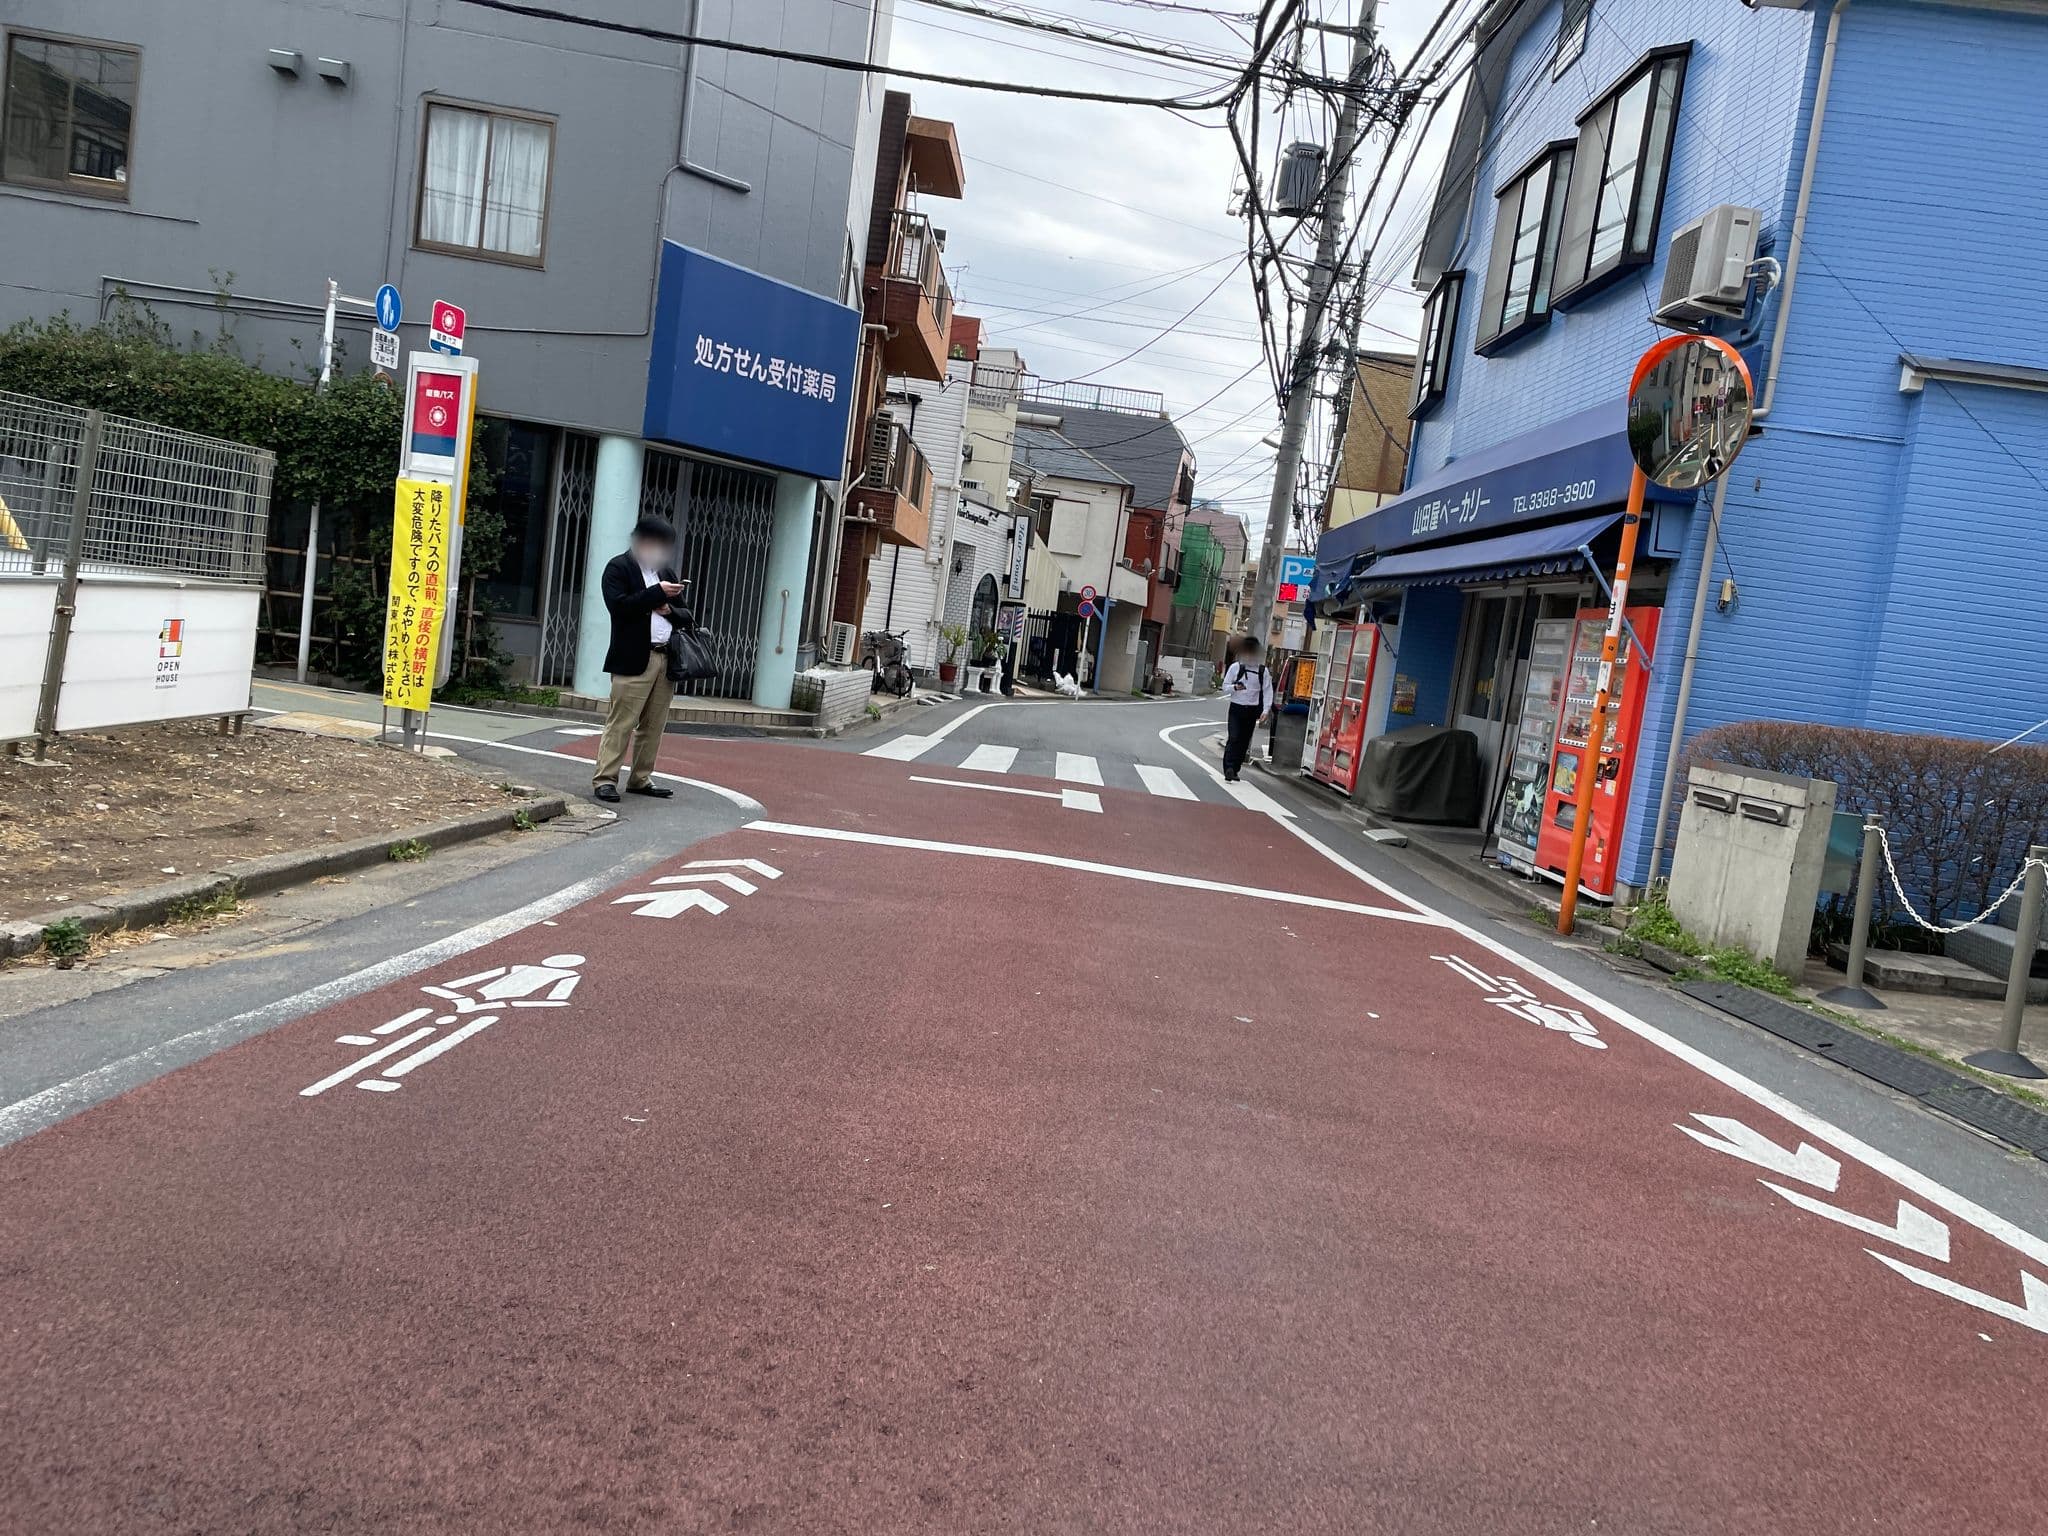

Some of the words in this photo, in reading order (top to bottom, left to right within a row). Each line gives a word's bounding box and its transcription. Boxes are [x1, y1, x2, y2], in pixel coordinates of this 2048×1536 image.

[694, 334, 836, 403] 処方せん受付薬局
[1411, 487, 1491, 536] 山田屋ベーカリー
[1512, 495, 1527, 513] TEL
[1528, 479, 1596, 511] 3388-3900
[412, 489, 443, 688] 降りたバスの直前、直後の横断は
[1283, 560, 1303, 584] P
[157, 661, 181, 672] OPEN
[384, 595, 401, 700] 関東バス株式会社
[155, 673, 178, 683] HOUSE
